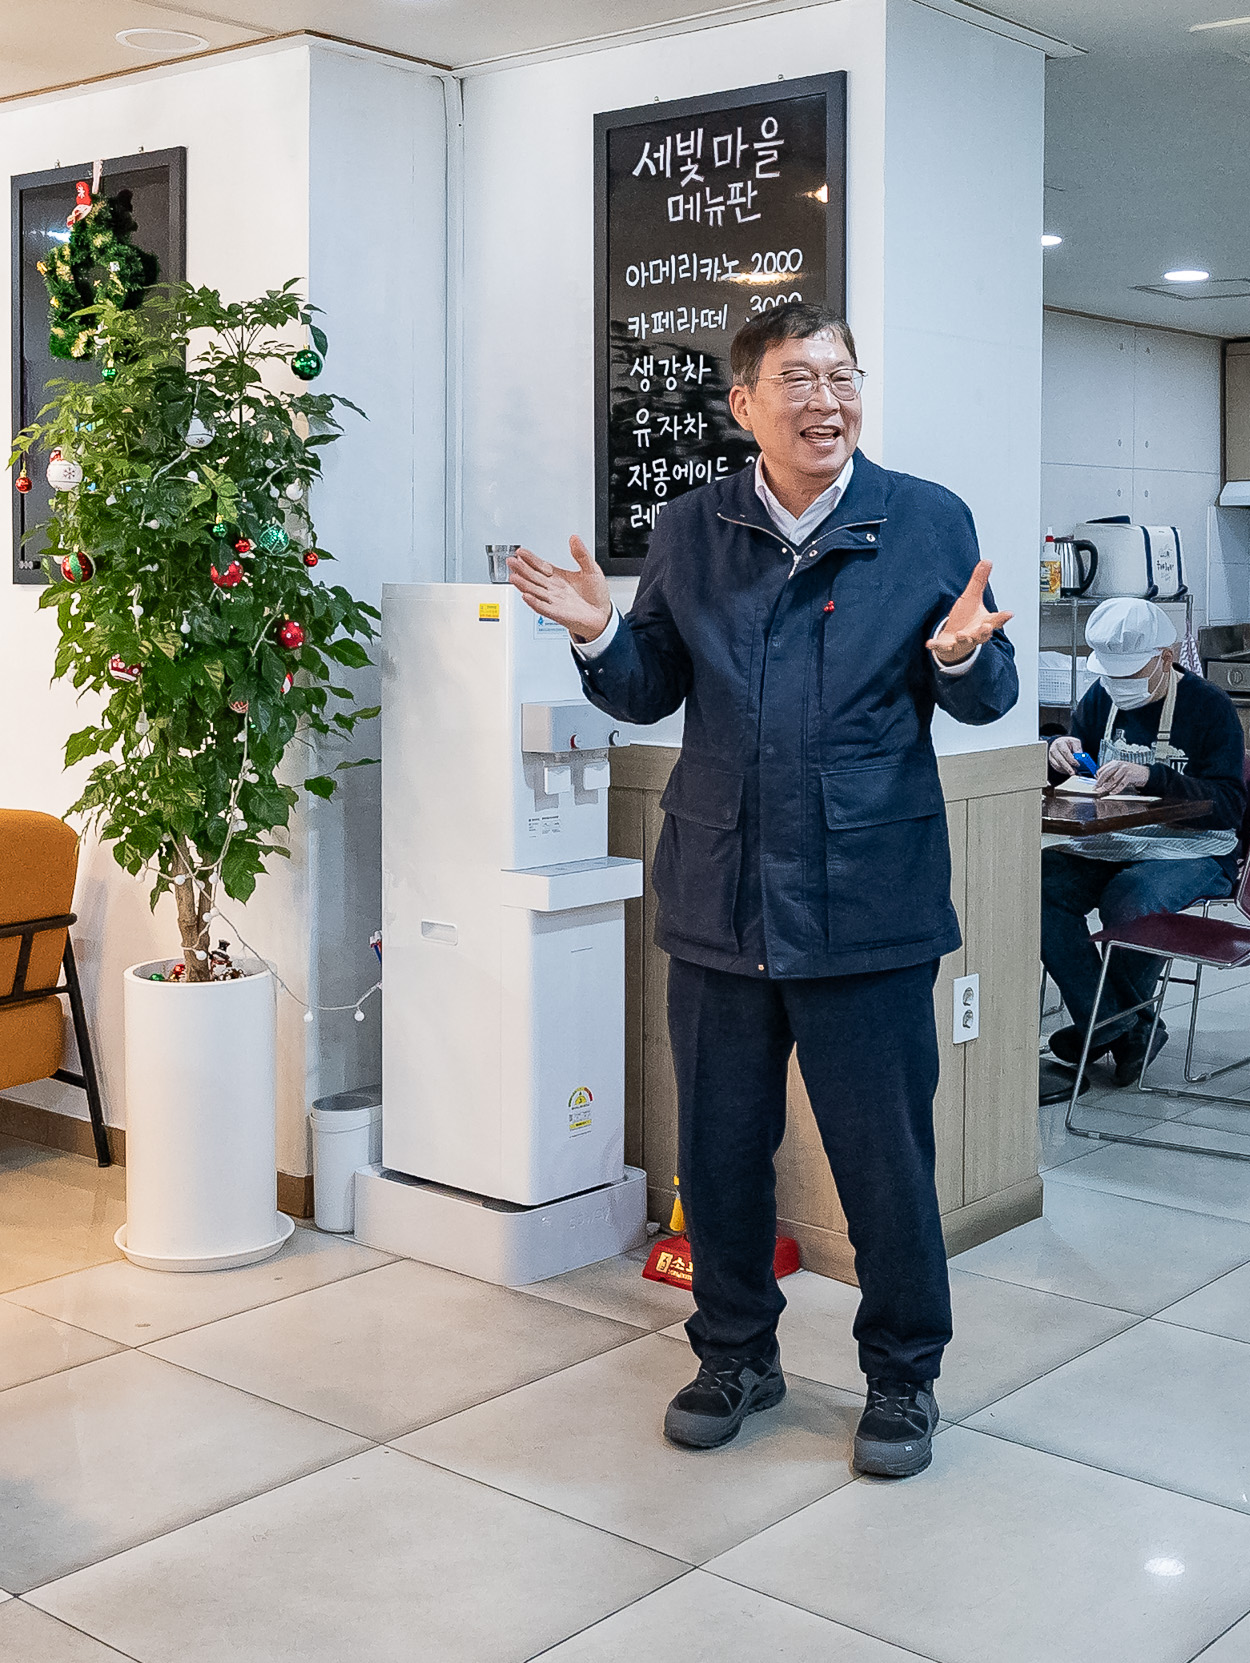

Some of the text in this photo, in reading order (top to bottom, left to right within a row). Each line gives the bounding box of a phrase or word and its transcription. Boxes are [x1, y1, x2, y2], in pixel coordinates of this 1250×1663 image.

[667, 180, 762, 227] 메뉴판
[625, 248, 804, 288] 아메리카노 2000
[627, 303, 729, 340] 카페라떼
[629, 354, 712, 393] 생강차
[632, 407, 708, 449] 유자차
[627, 456, 730, 498] 자몽에이드
